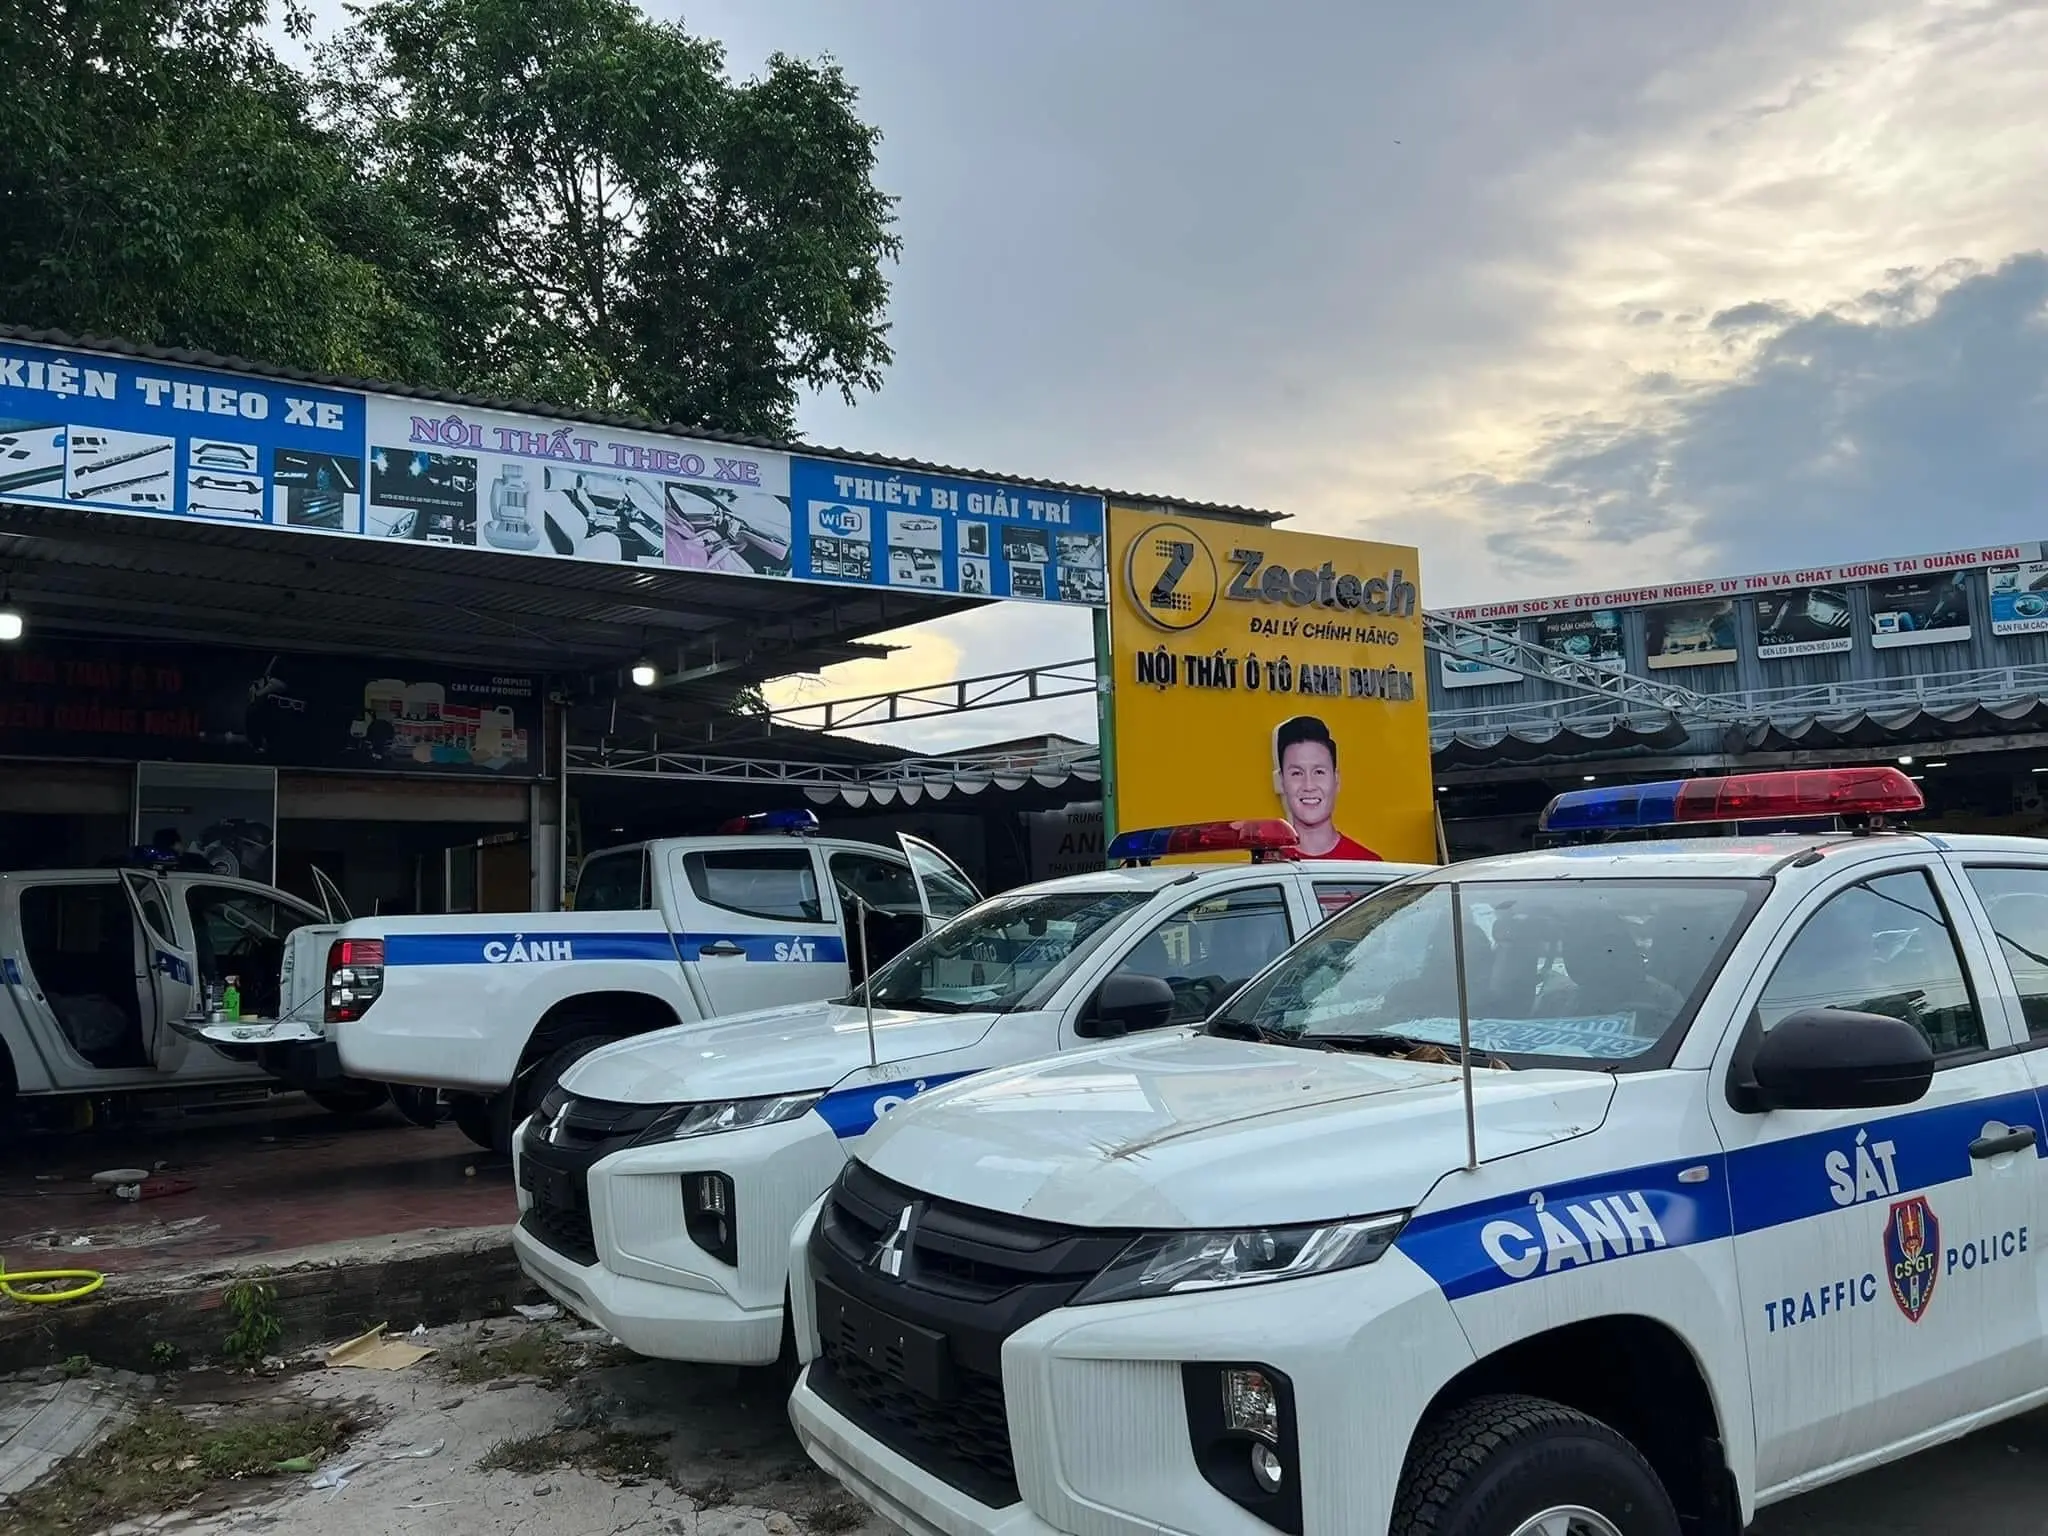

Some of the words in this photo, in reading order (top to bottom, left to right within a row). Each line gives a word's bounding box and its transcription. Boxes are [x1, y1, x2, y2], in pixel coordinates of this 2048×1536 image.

[136, 376, 268, 420] THEO
[285, 398, 344, 431] XE
[410, 414, 482, 449] NỘI
[494, 426, 598, 463] THẤT
[608, 442, 705, 477] THEO
[713, 457, 761, 482] XE
[834, 475, 922, 507] THIẾT
[931, 488, 959, 517] BỊ
[967, 488, 1020, 519] GIẢI
[1027, 495, 1071, 525] TRÍ
[1224, 547, 1416, 617] Zestech
[1553, 598, 1569, 610] XE
[1250, 617, 1279, 638] ĐẠI
[1282, 617, 1299, 637] LÝ
[1302, 621, 1351, 642] CHÍNH
[1136, 645, 1177, 691] NỘI
[1184, 648, 1238, 689] THẤT
[1245, 651, 1260, 690] Ô
[1266, 654, 1292, 694] TÔ
[484, 933, 573, 963] CẢNH
[775, 937, 815, 963] SÁT
[1481, 1192, 1666, 1279] CẢNH
[1825, 1128, 1900, 1205] SÁT
[1765, 1272, 1877, 1334] TRAFFIC
[1947, 1226, 2029, 1276] POLICE
